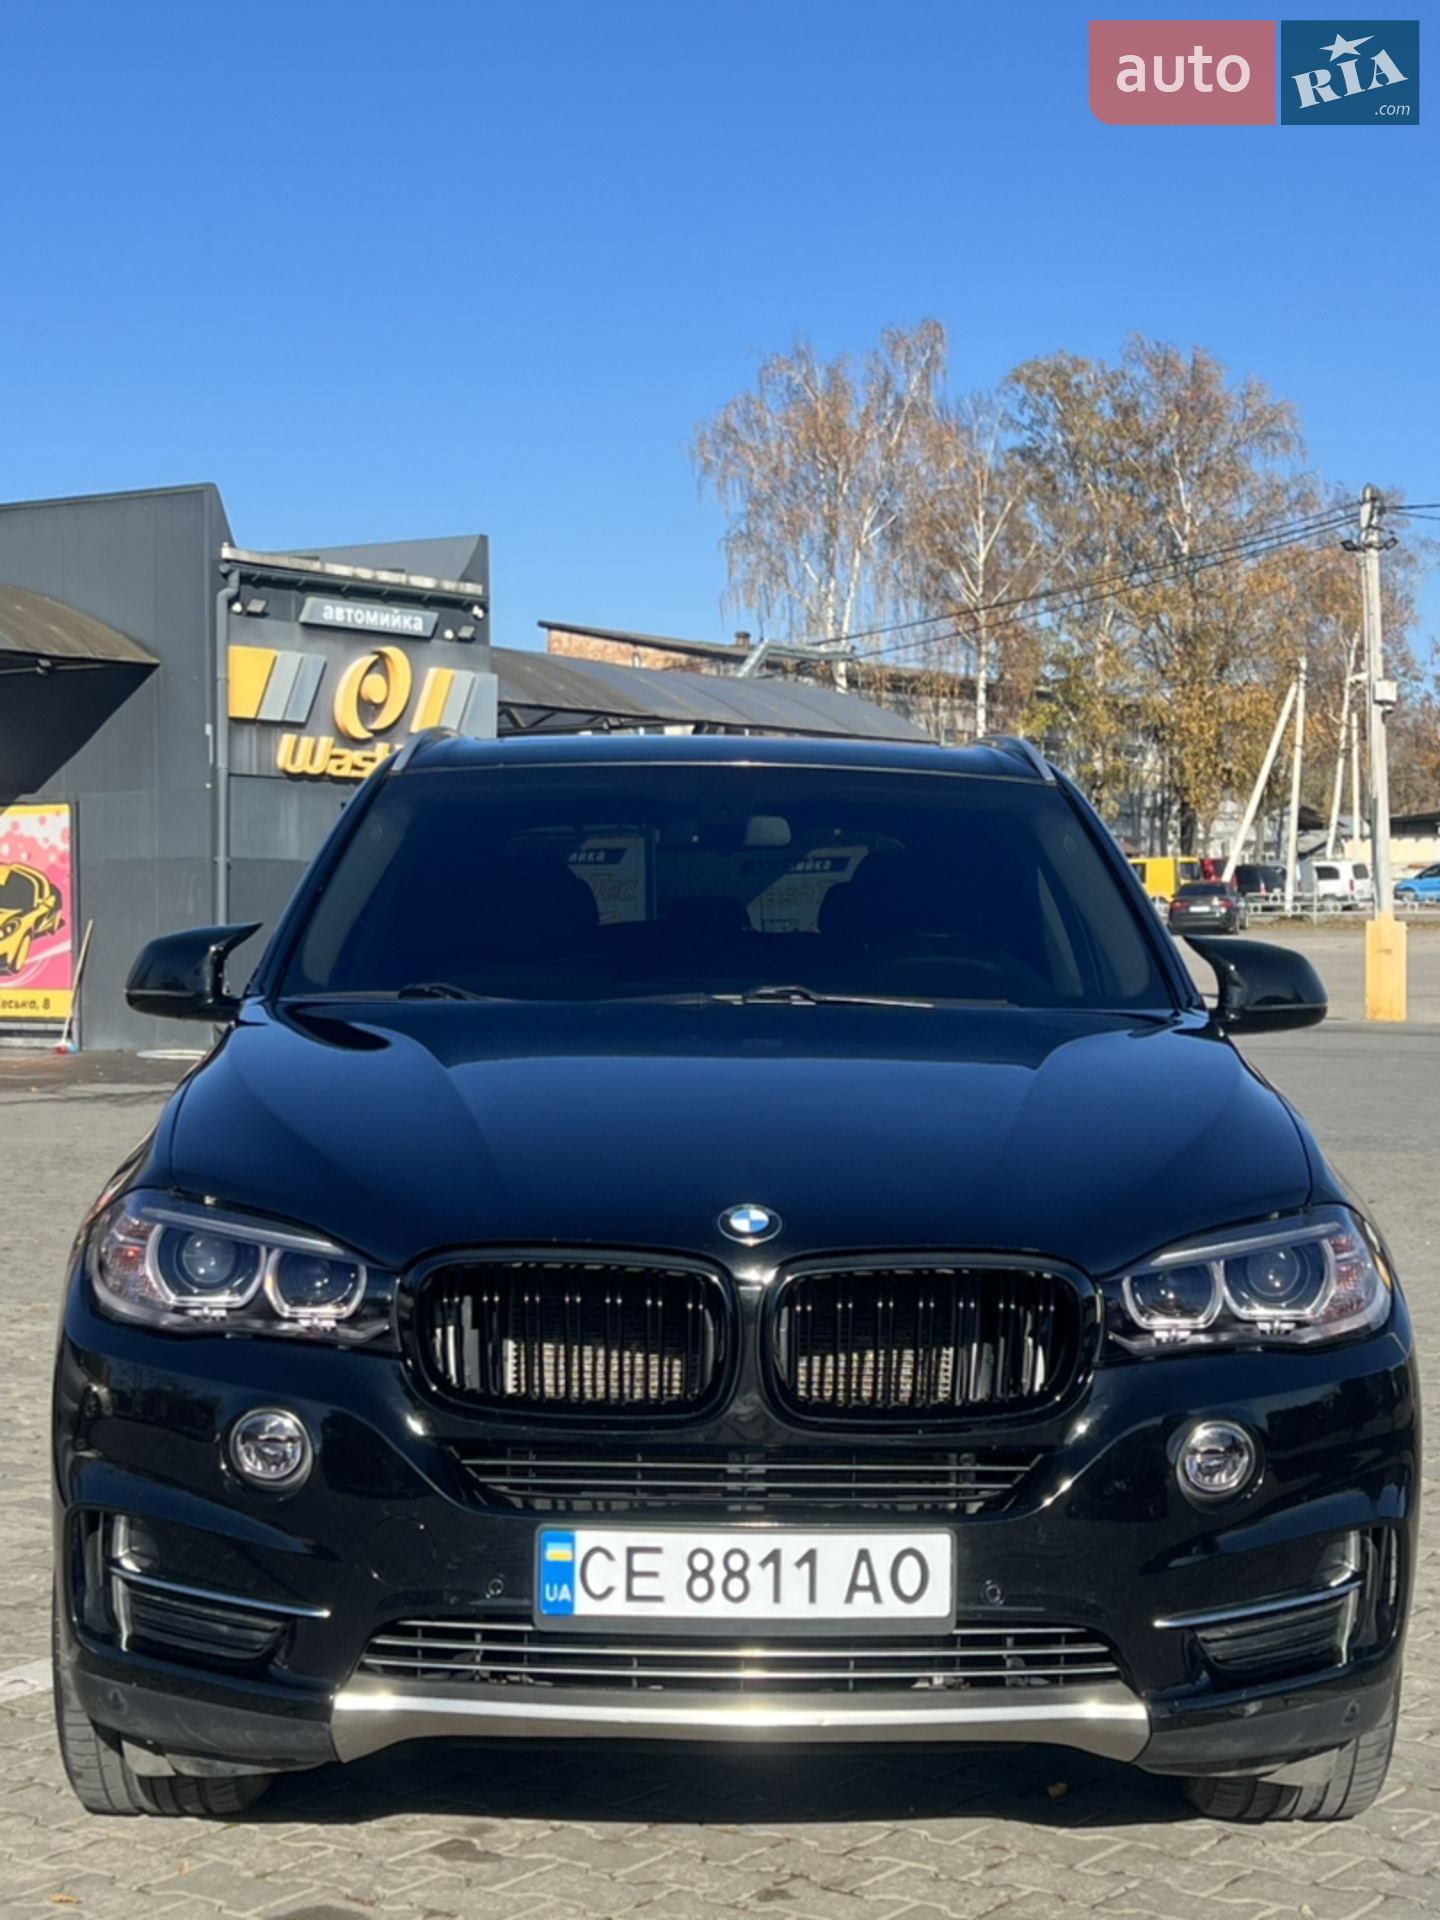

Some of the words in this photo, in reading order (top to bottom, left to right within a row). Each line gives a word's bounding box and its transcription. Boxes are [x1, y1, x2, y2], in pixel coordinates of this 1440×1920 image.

[322, 604, 424, 632] автомийка
[545, 1583, 572, 1602] UA
[579, 1546, 665, 1603] CE
[685, 1547, 818, 1605] 8811
